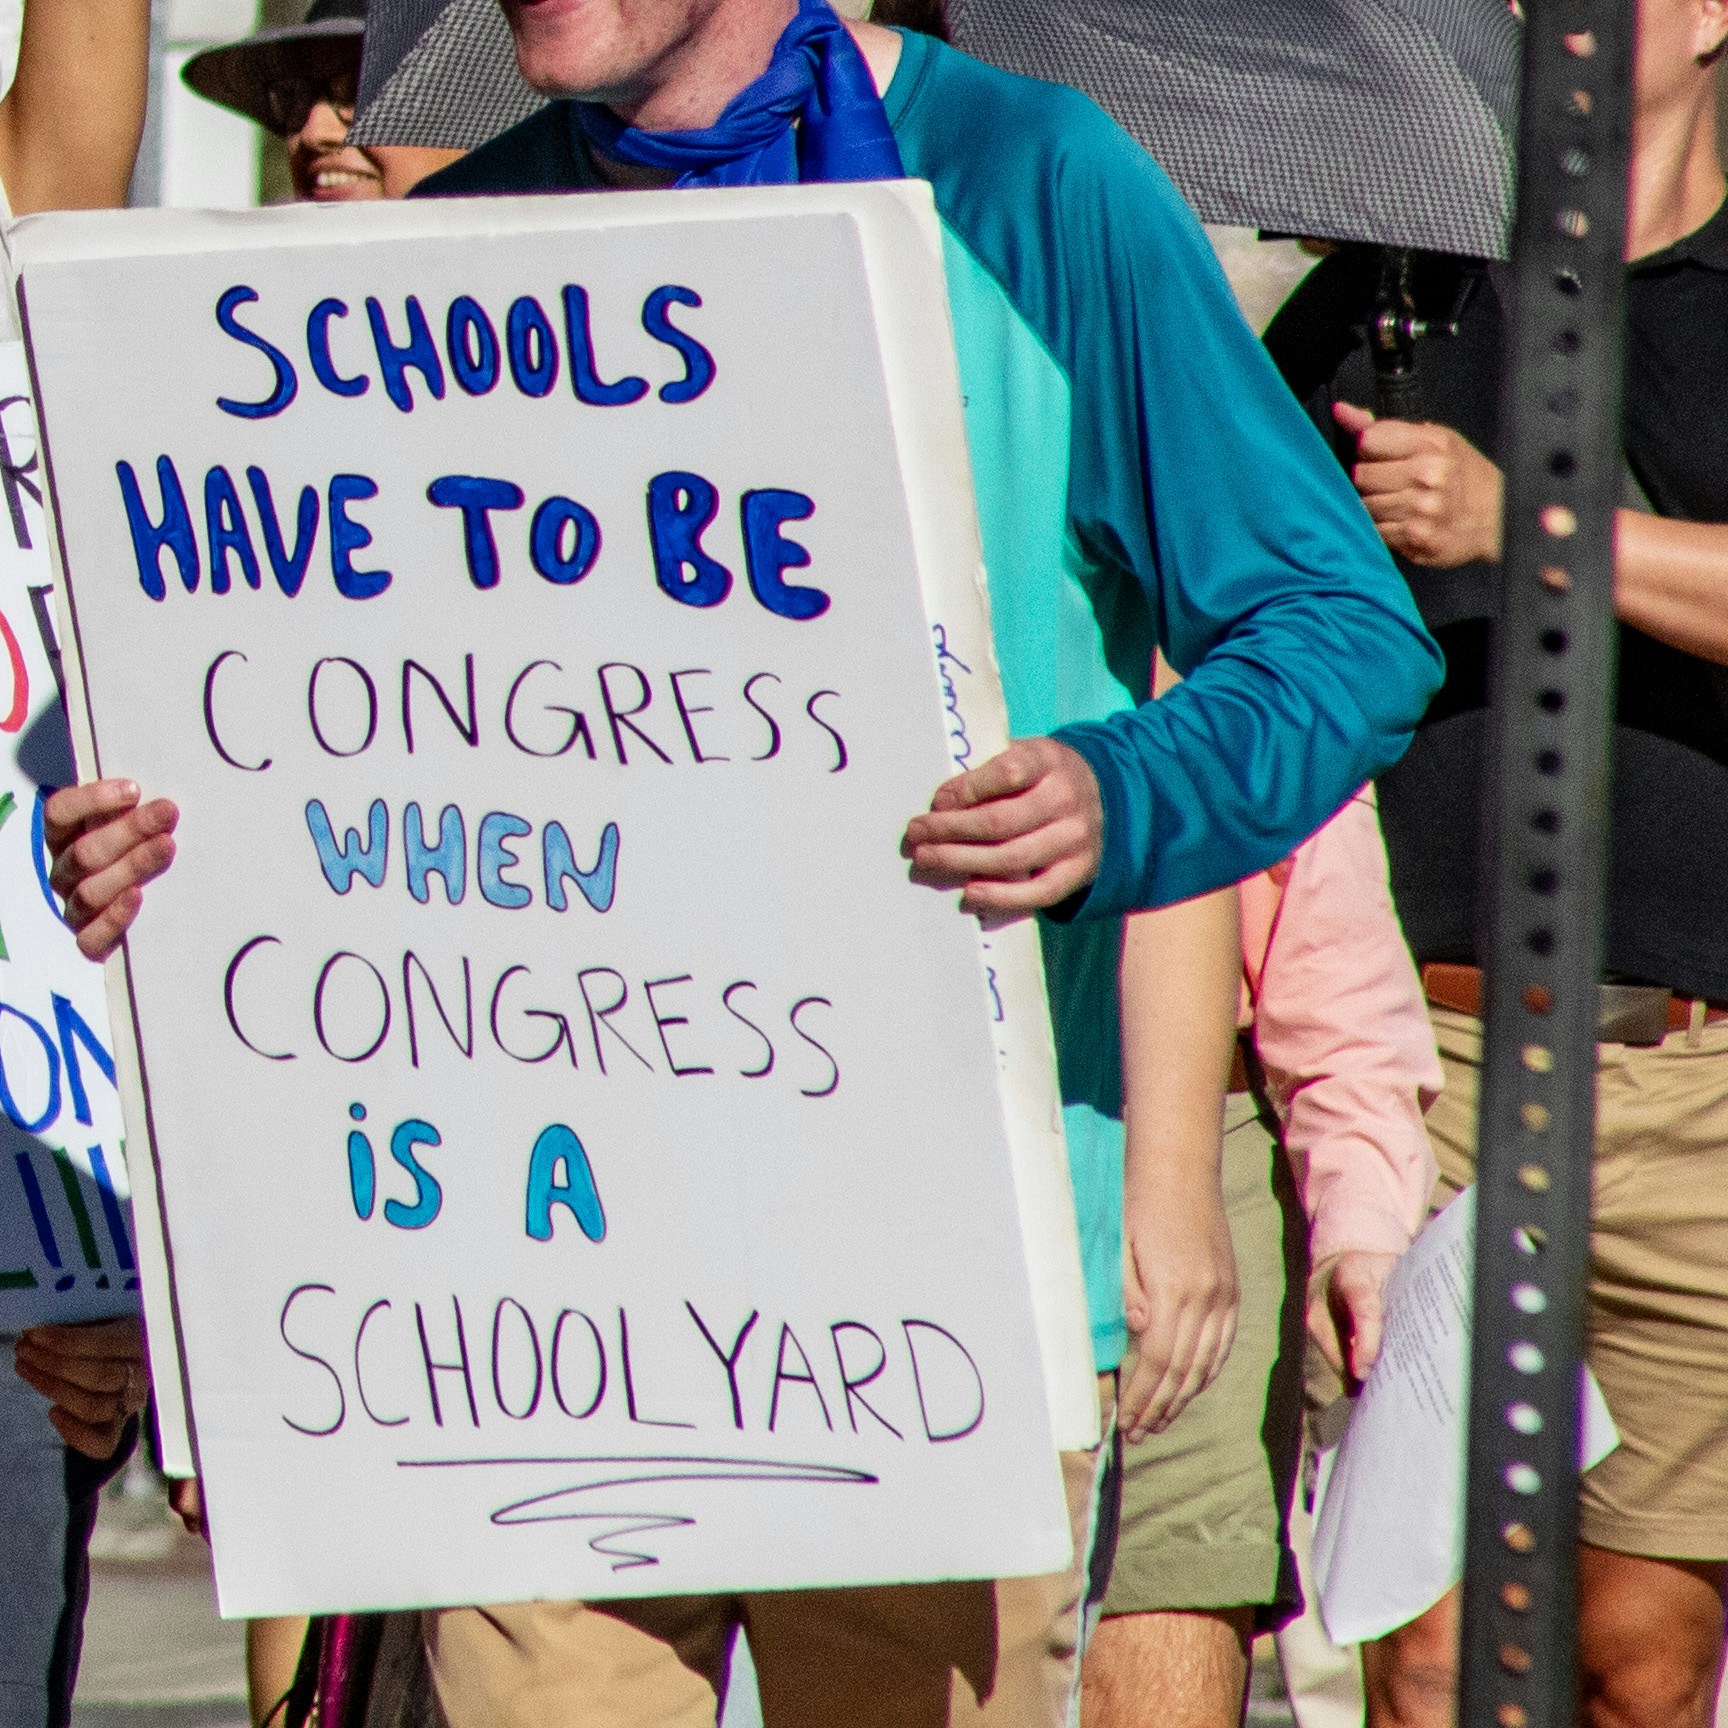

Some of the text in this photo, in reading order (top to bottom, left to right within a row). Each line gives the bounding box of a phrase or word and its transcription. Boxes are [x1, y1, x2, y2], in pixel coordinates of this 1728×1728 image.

[214, 282, 718, 420] SCHOOLS
[114, 453, 832, 621] HAVE TO BE
[202, 649, 849, 774] CONGRESS
[304, 797, 622, 913] WHEN
[222, 934, 841, 1099] CONGRESS
[524, 1123, 608, 1244] A
[279, 1282, 986, 1445] SCHOOLYARD
